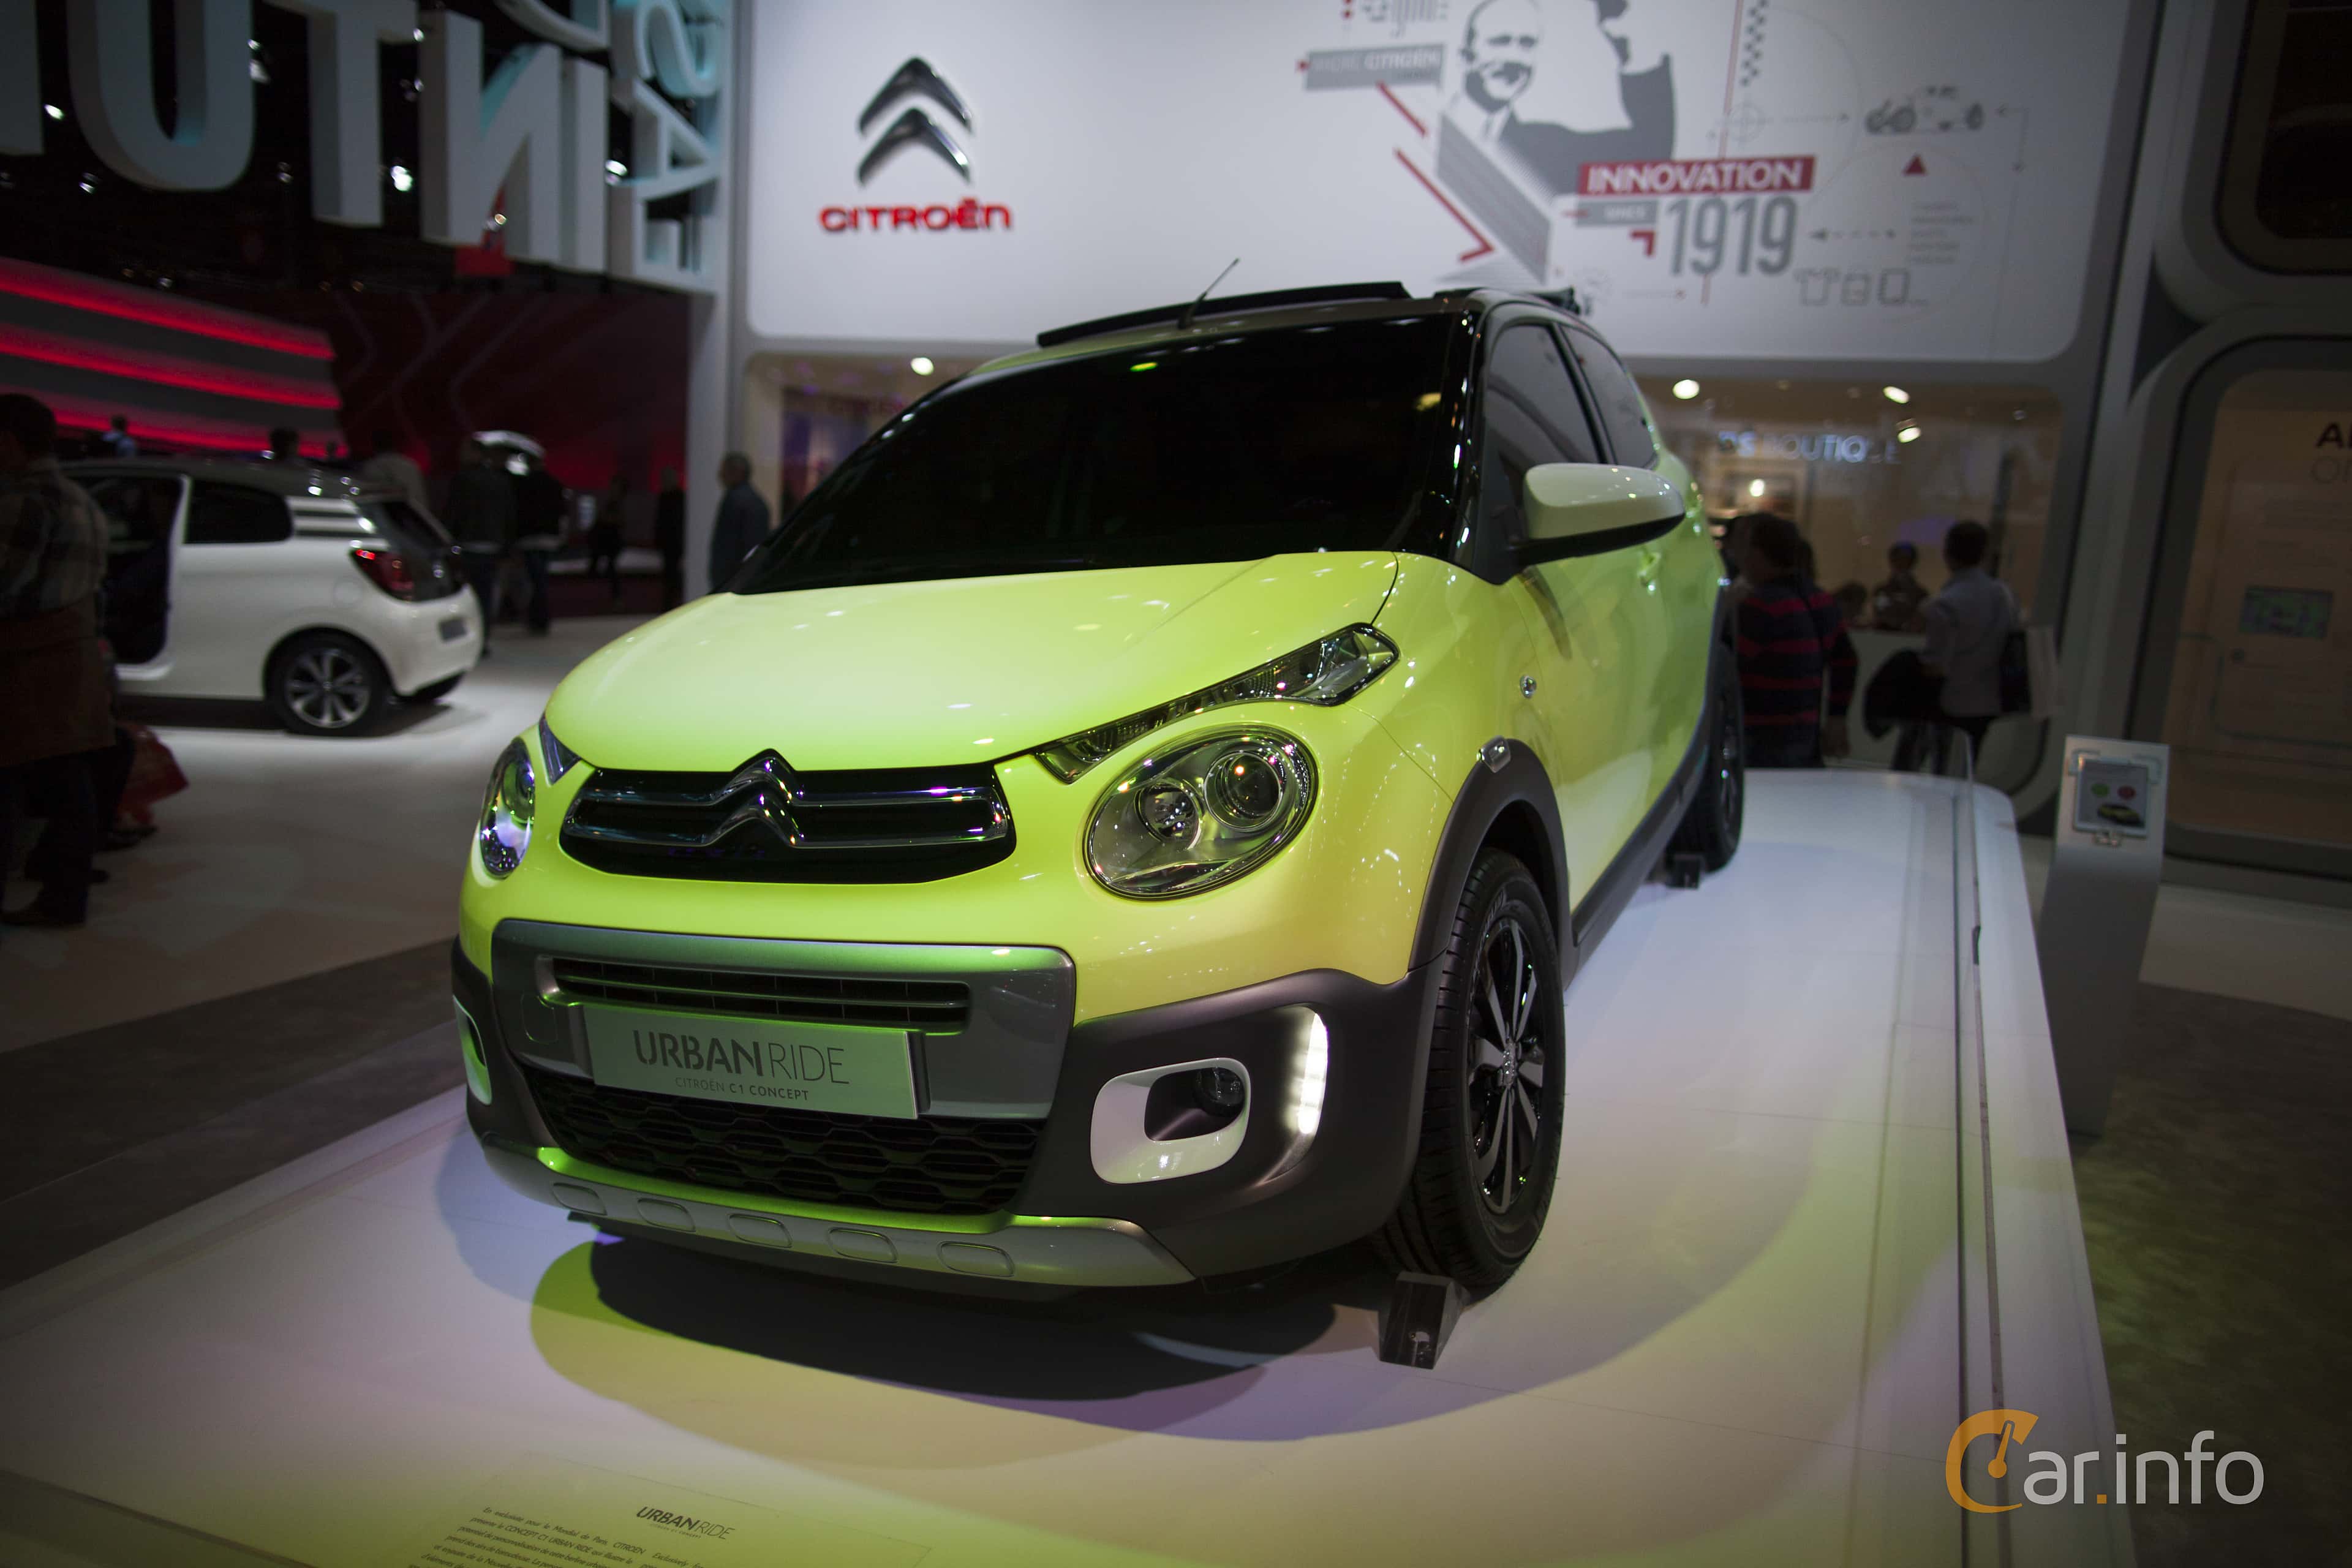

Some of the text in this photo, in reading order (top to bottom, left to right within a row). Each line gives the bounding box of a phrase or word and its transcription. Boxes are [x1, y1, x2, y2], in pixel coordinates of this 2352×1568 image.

[1588, 161, 1803, 192] INNOVATION
[1666, 195, 1797, 277] 1919
[729, 1083, 744, 1094] C1
[749, 1085, 809, 1101] CONCEPT
